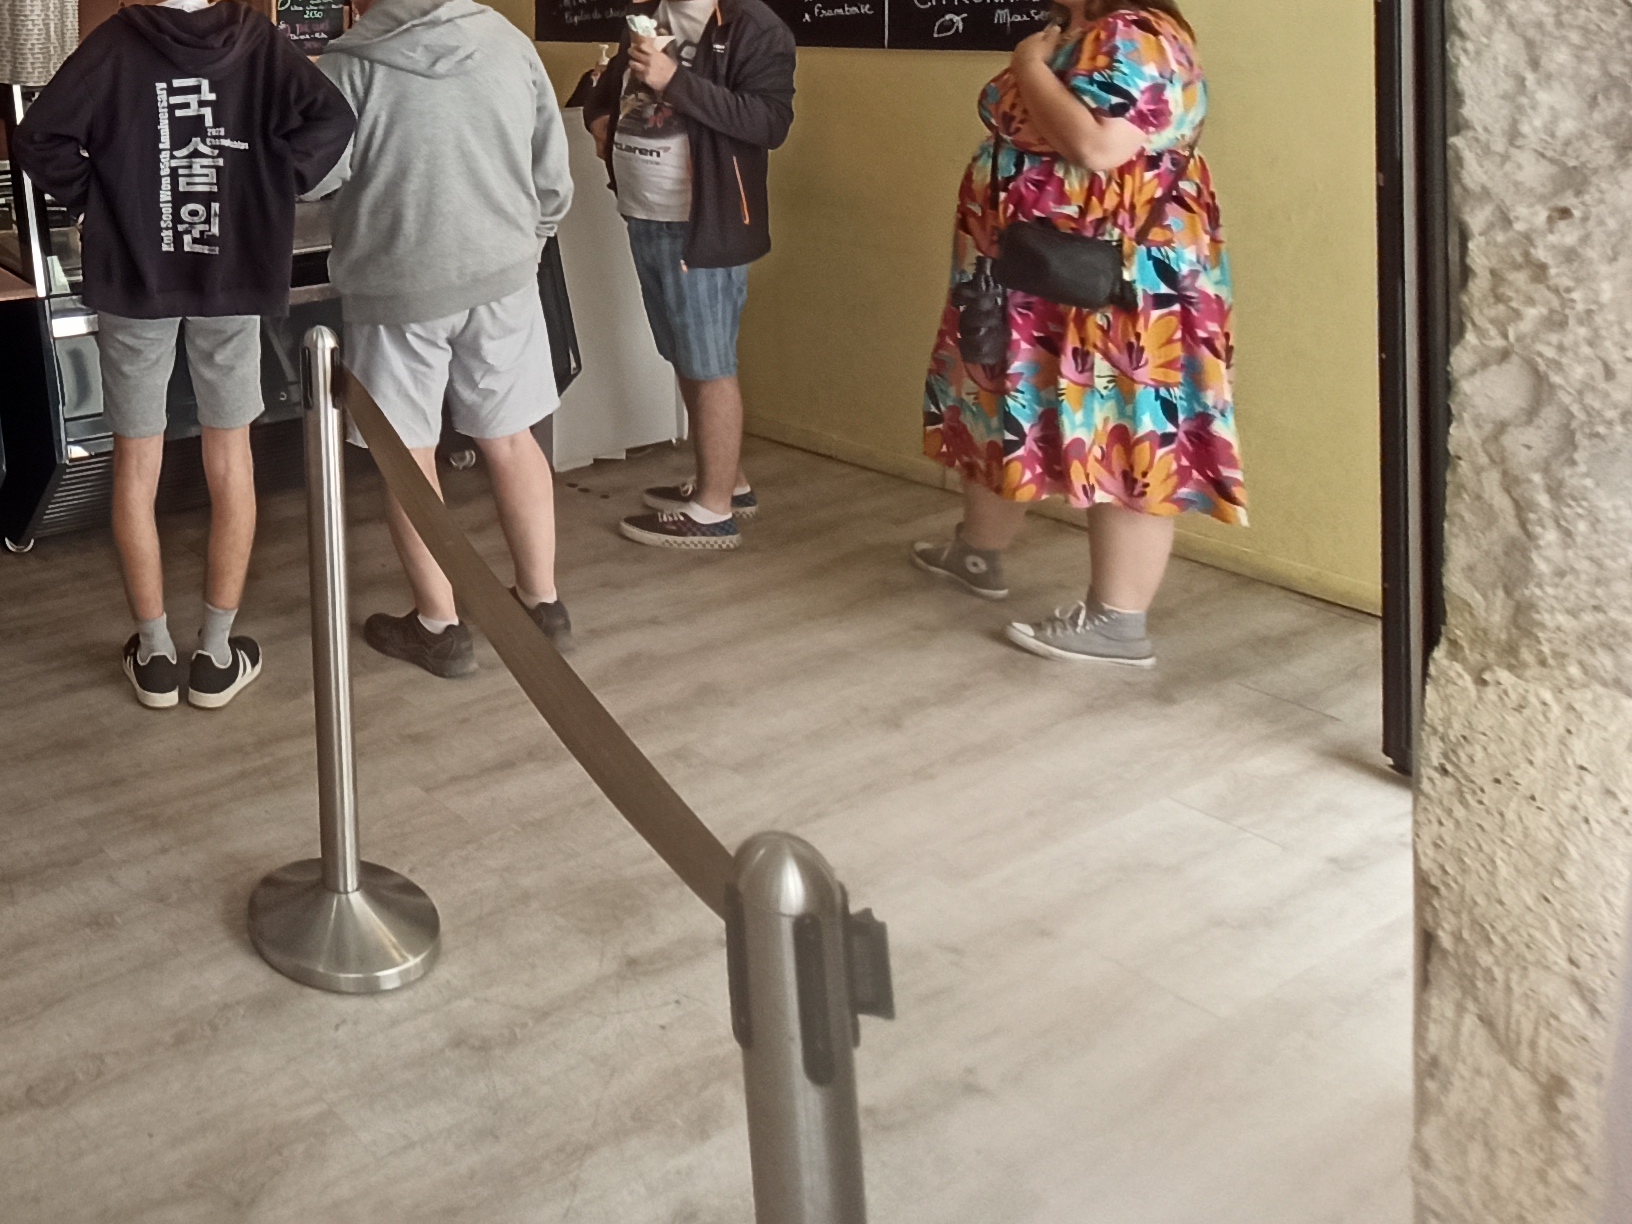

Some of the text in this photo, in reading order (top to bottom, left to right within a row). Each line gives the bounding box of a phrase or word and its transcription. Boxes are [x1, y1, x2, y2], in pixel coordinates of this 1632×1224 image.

[814, 2, 875, 18] Framboise
[993, 7, 1053, 37] Maiso
[159, 177, 172, 202] Won
[159, 203, 173, 228] Sool
[161, 229, 175, 252] Kuk
